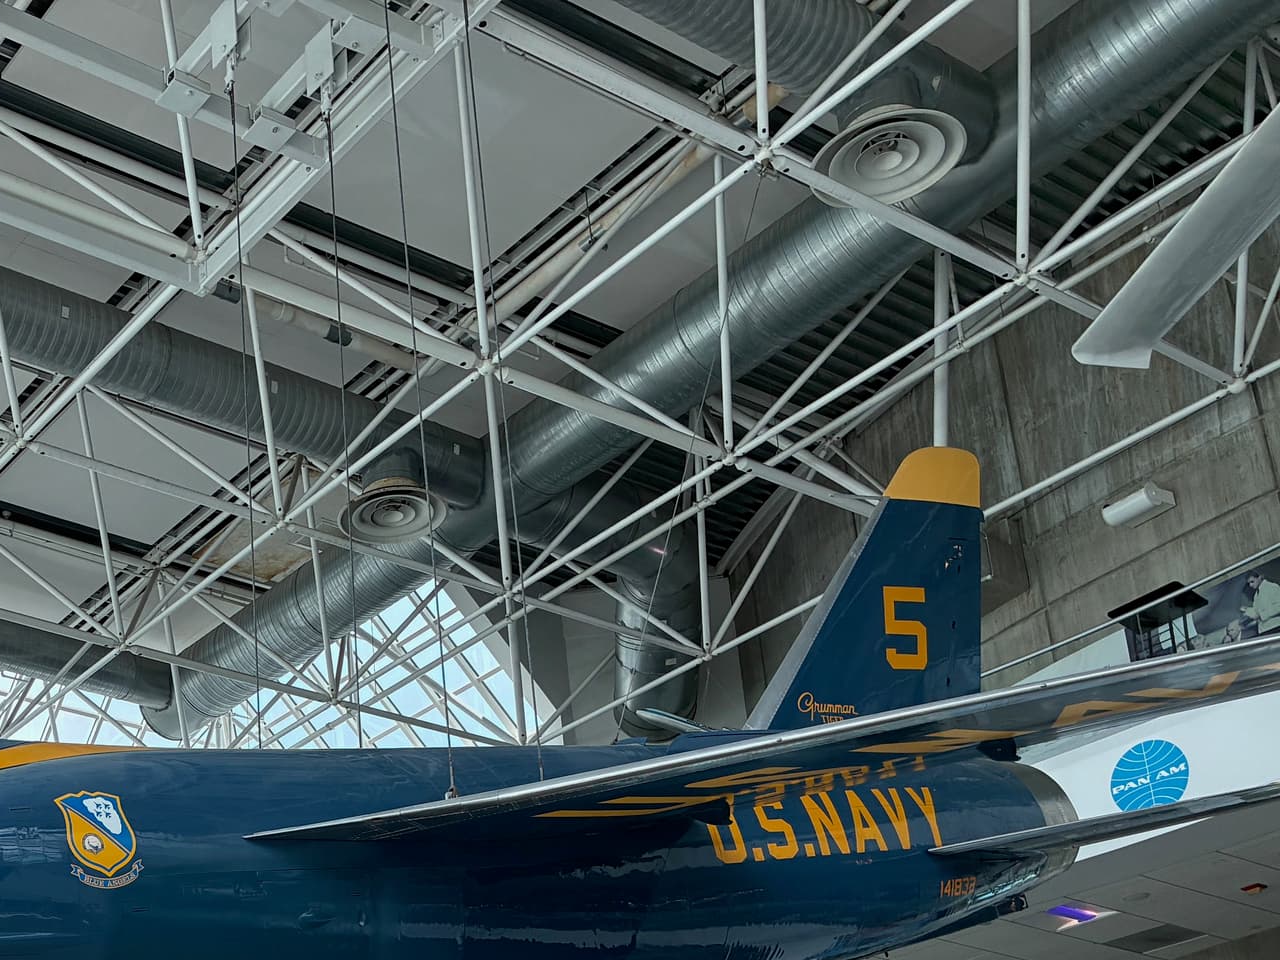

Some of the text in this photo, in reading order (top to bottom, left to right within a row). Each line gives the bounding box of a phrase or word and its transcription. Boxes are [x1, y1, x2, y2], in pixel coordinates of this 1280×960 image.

[883, 586, 928, 670] 5
[798, 691, 859, 720] Grumman
[1112, 762, 1187, 795] PAN AM
